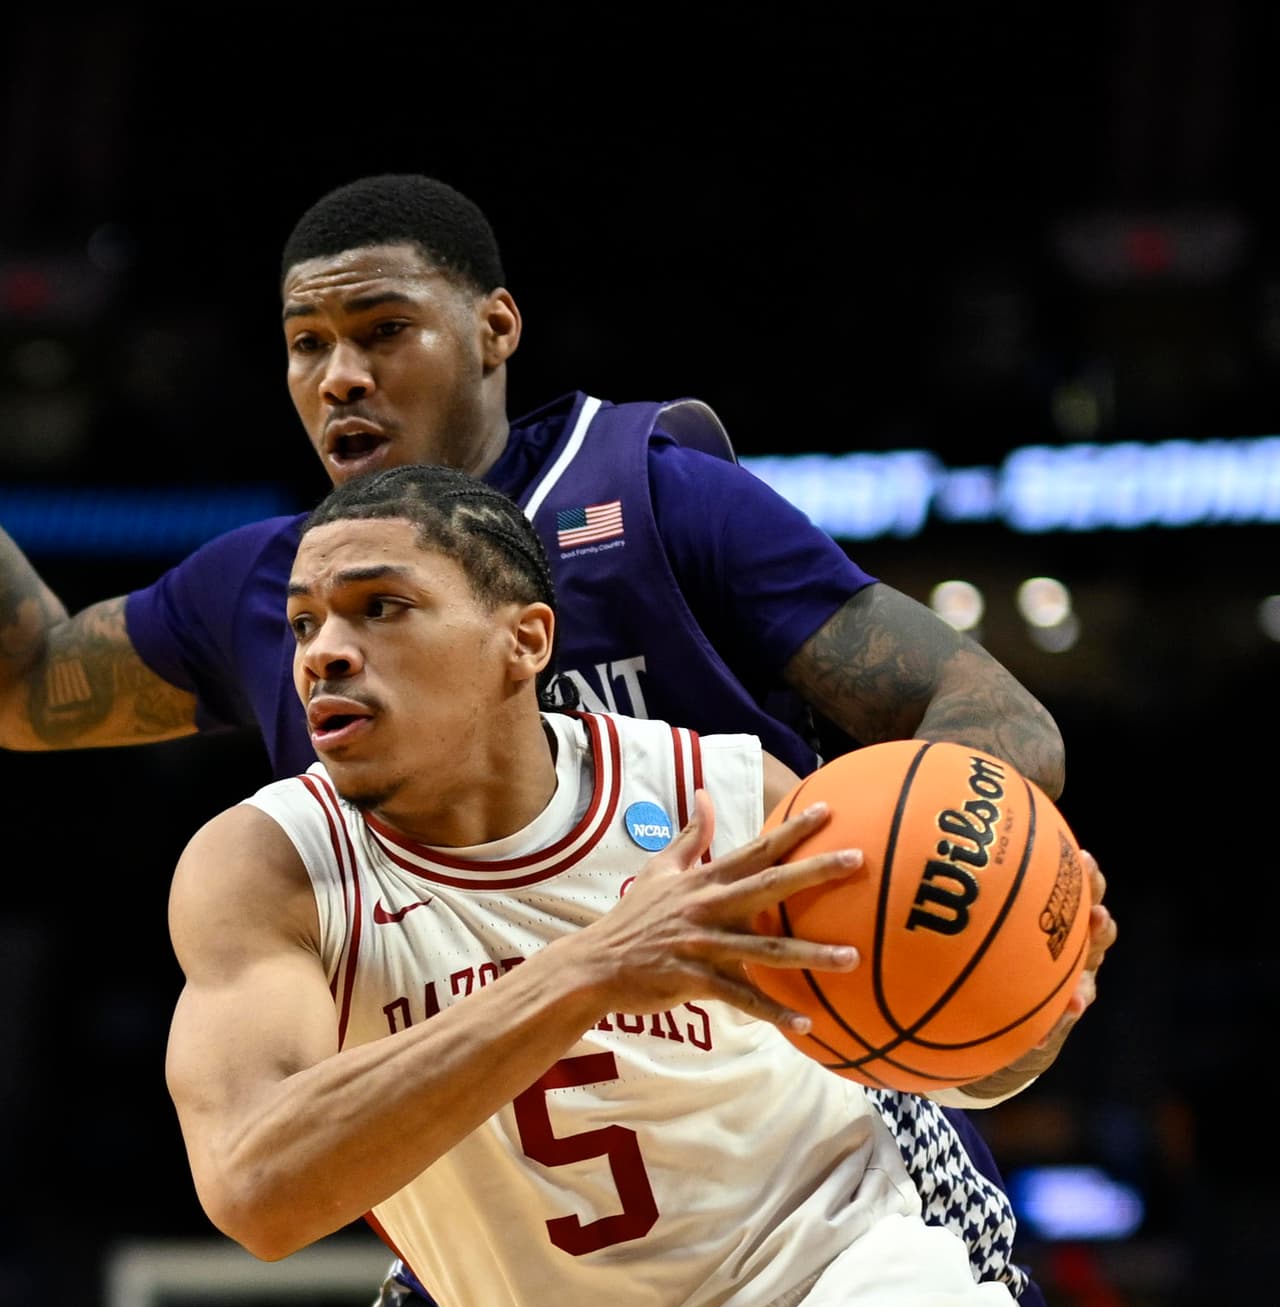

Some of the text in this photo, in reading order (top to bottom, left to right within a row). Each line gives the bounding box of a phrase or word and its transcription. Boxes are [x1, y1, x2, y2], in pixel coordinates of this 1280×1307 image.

[633, 824, 672, 839] NCAA
[905, 755, 1006, 936] Wilson
[513, 1052, 659, 1256] 5
